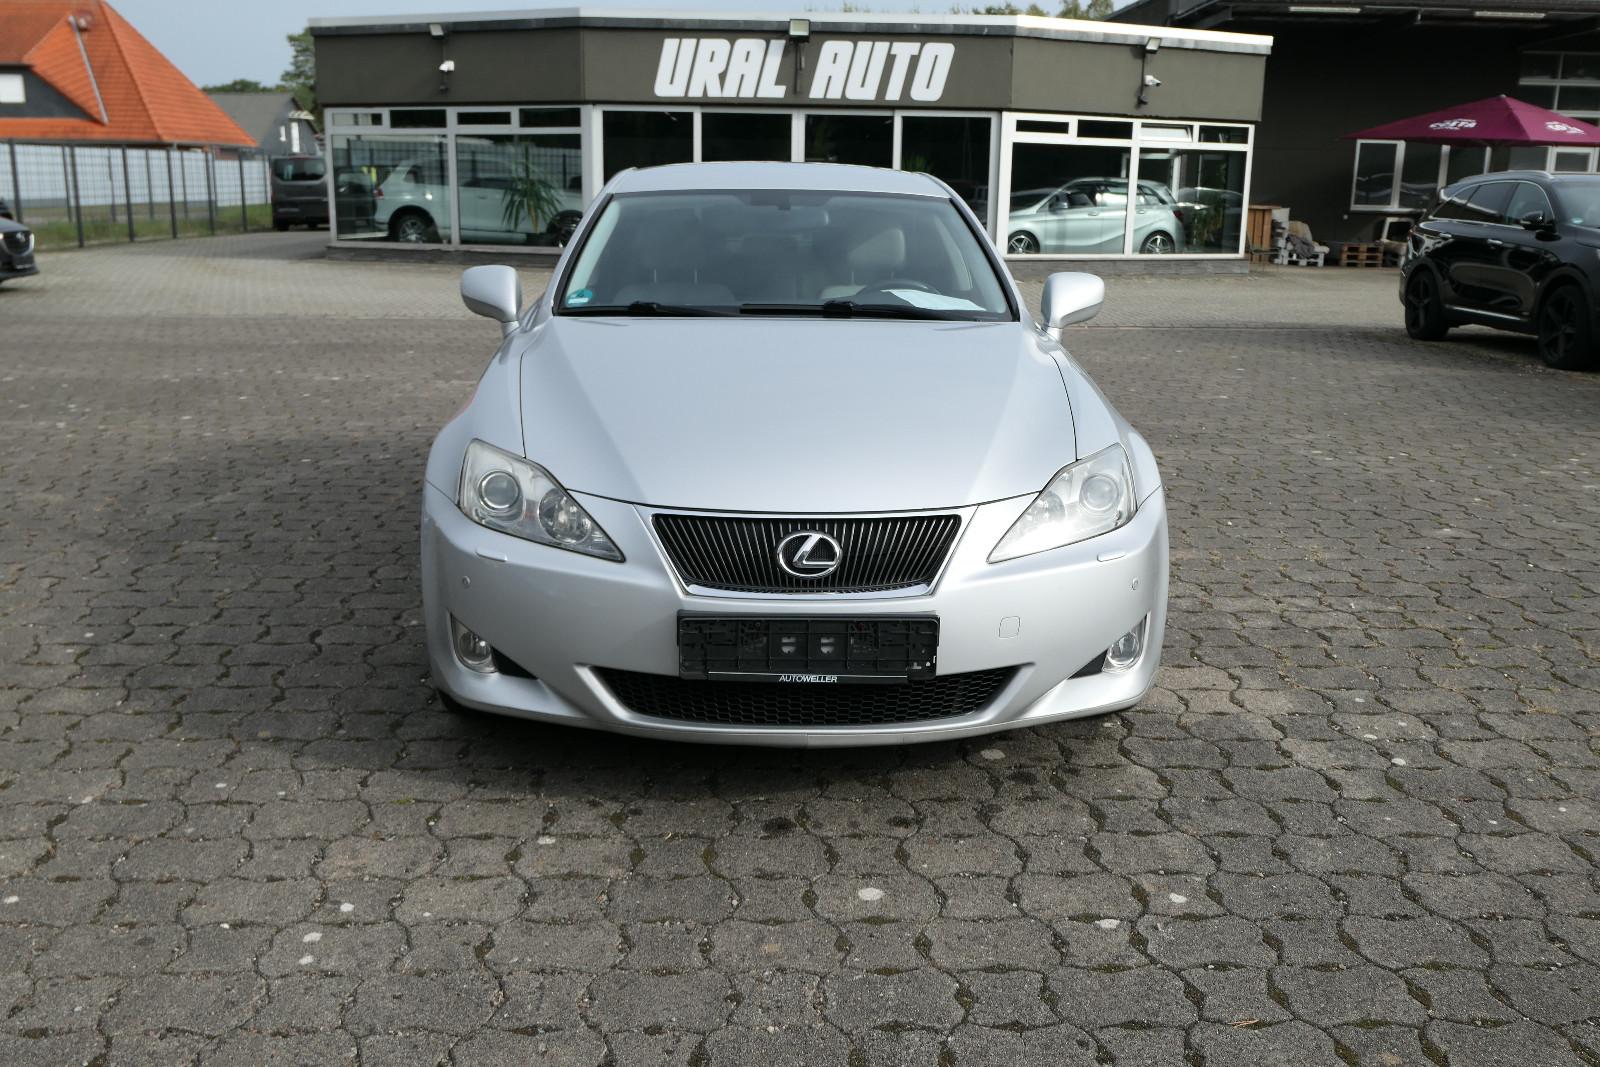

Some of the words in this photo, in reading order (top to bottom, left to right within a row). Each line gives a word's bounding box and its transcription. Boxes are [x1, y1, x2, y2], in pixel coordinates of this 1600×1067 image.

[654, 38, 787, 98] URAL
[808, 40, 956, 102] AUTO
[779, 675, 838, 683] AUTOWELLER
